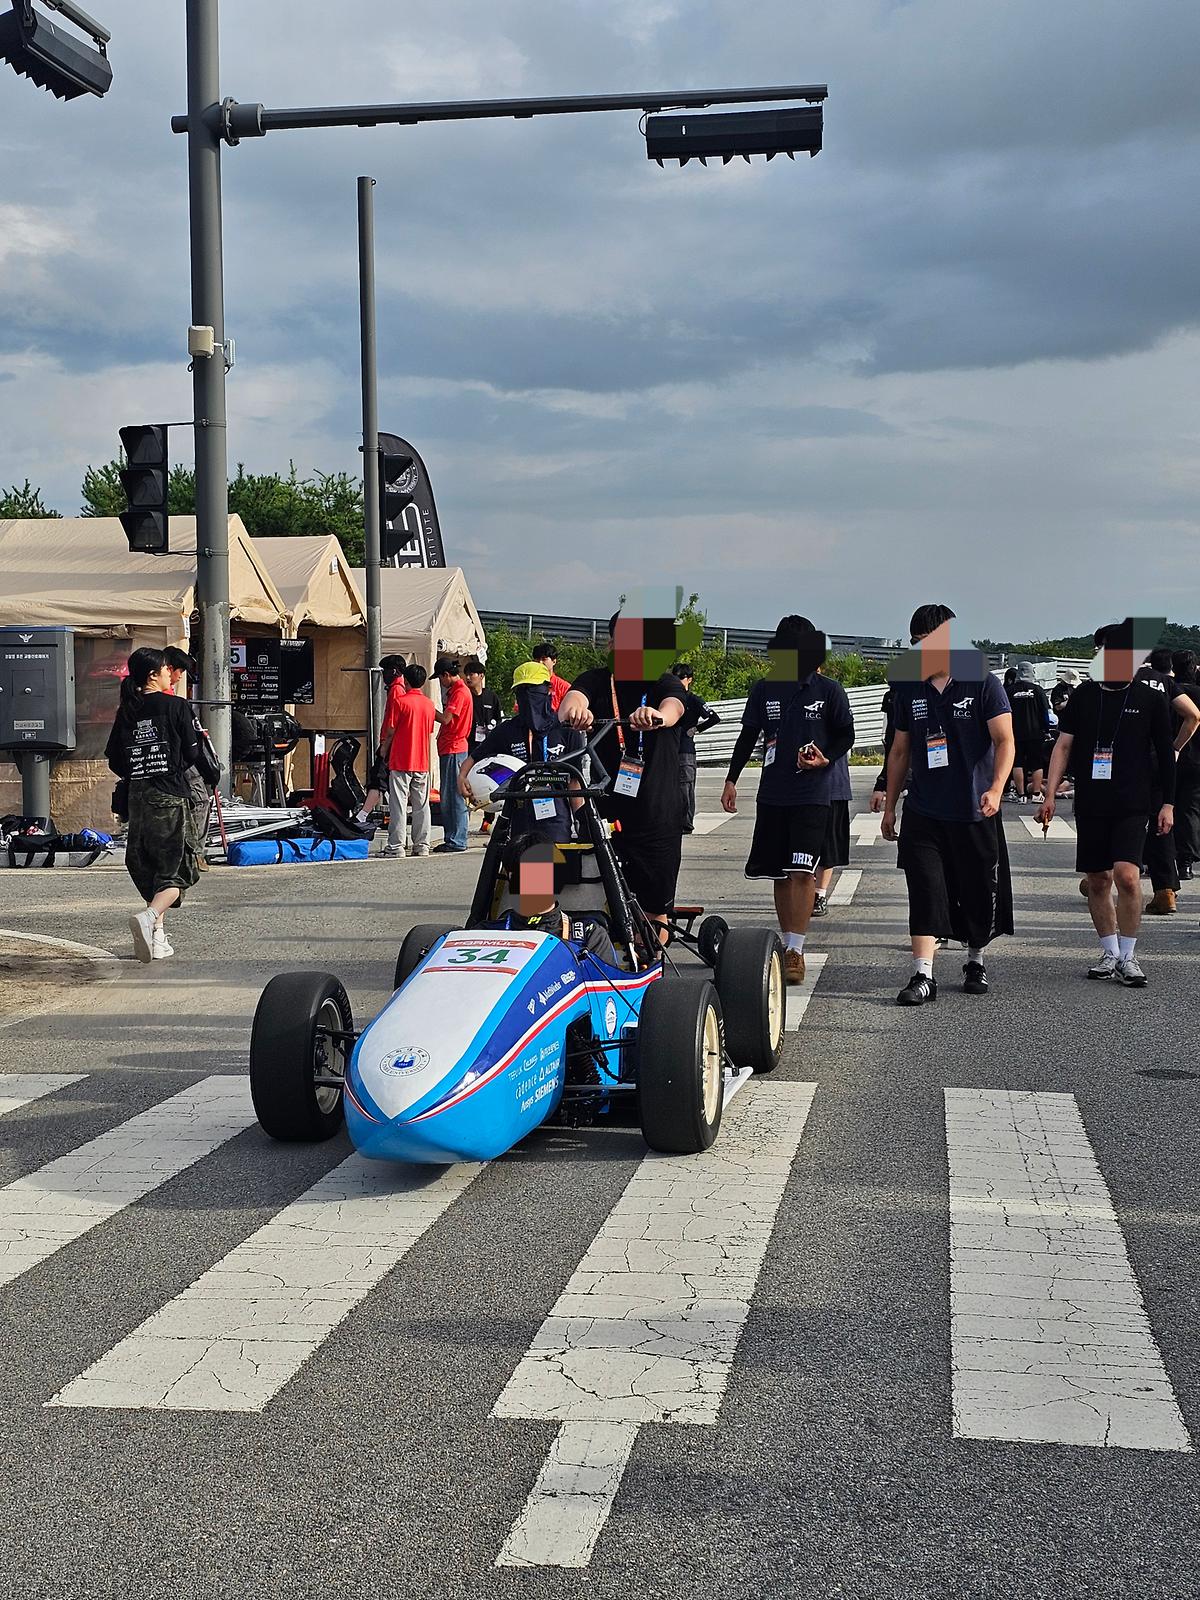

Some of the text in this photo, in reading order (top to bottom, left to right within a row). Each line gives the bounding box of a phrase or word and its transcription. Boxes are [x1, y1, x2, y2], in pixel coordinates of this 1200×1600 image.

[422, 508, 438, 566] STITUTE
[453, 940, 527, 948] FORMULA
[447, 948, 511, 964] 34
